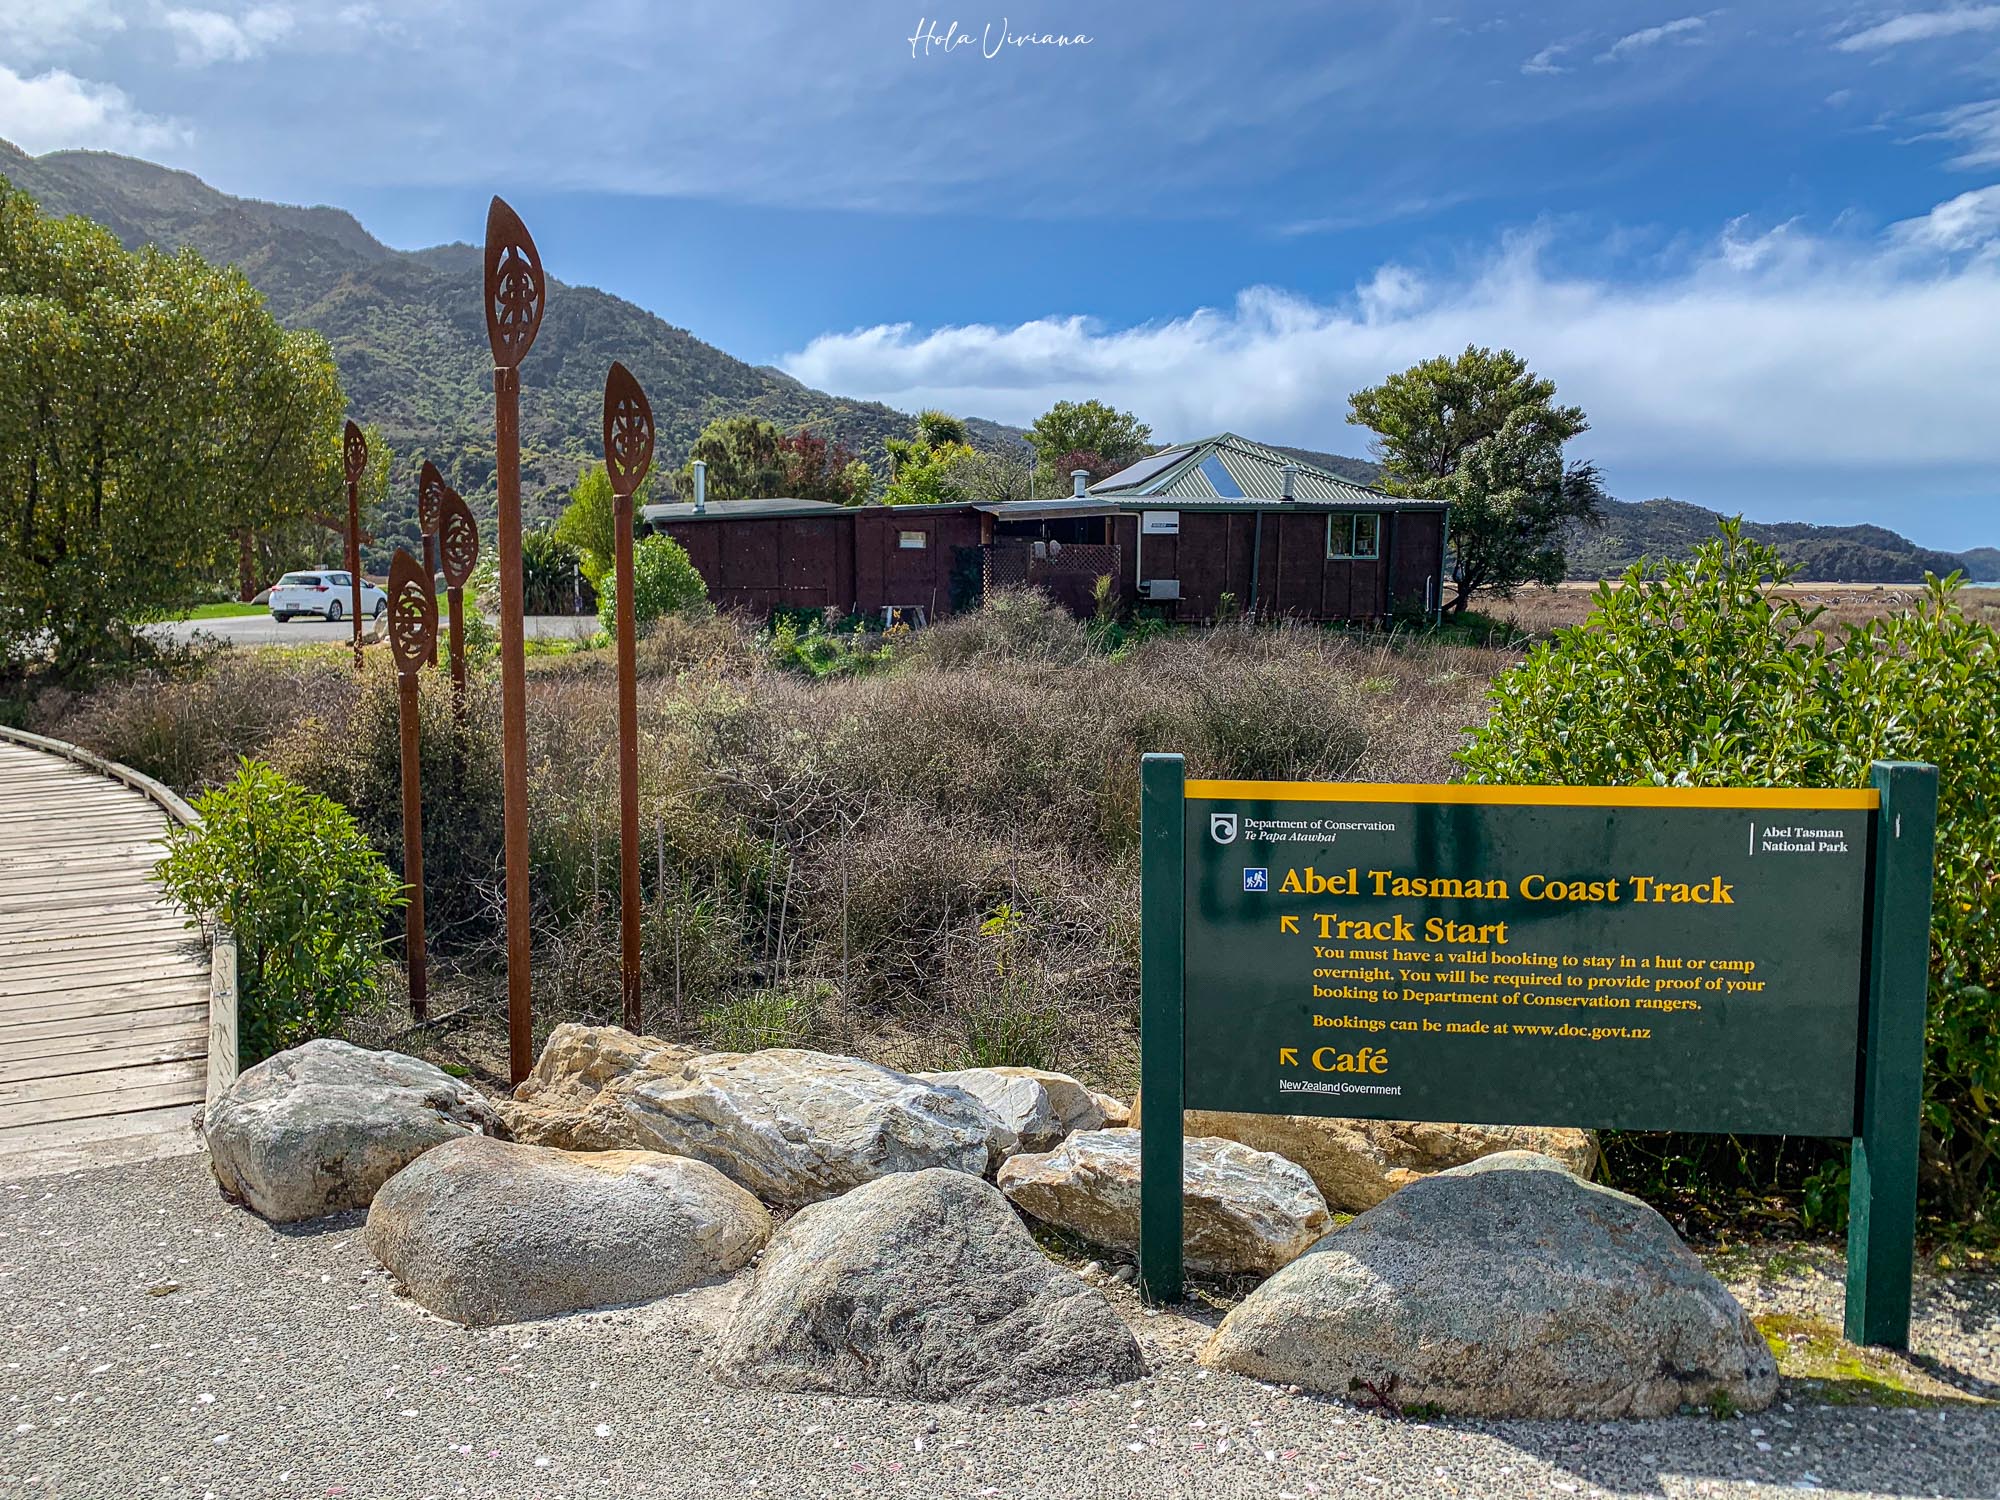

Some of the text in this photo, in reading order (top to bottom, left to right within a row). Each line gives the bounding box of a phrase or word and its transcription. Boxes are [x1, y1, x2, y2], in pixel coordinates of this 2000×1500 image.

[1244, 818, 1395, 831] Department of Conservation
[1244, 831, 1336, 843] Te Papa Atawhai
[1762, 827, 1844, 838] Abel Tasman
[1762, 841, 1848, 852] National Park
[1279, 867, 1735, 904] Abel Tasman Coast Track
[1313, 913, 1509, 945] Track Start
[1313, 946, 1755, 974] You must have a valid booking to stay in a hut or camp
[1313, 967, 1765, 994] overnight. You will be required to provide proof of your
[1313, 985, 1702, 1012] booking to Department of Conservation rangers.
[1313, 1014, 1651, 1040] Bookings can be made at www.doc.govt.nz
[1312, 1047, 1389, 1074] Café
[1341, 1083, 1402, 1095] Government
